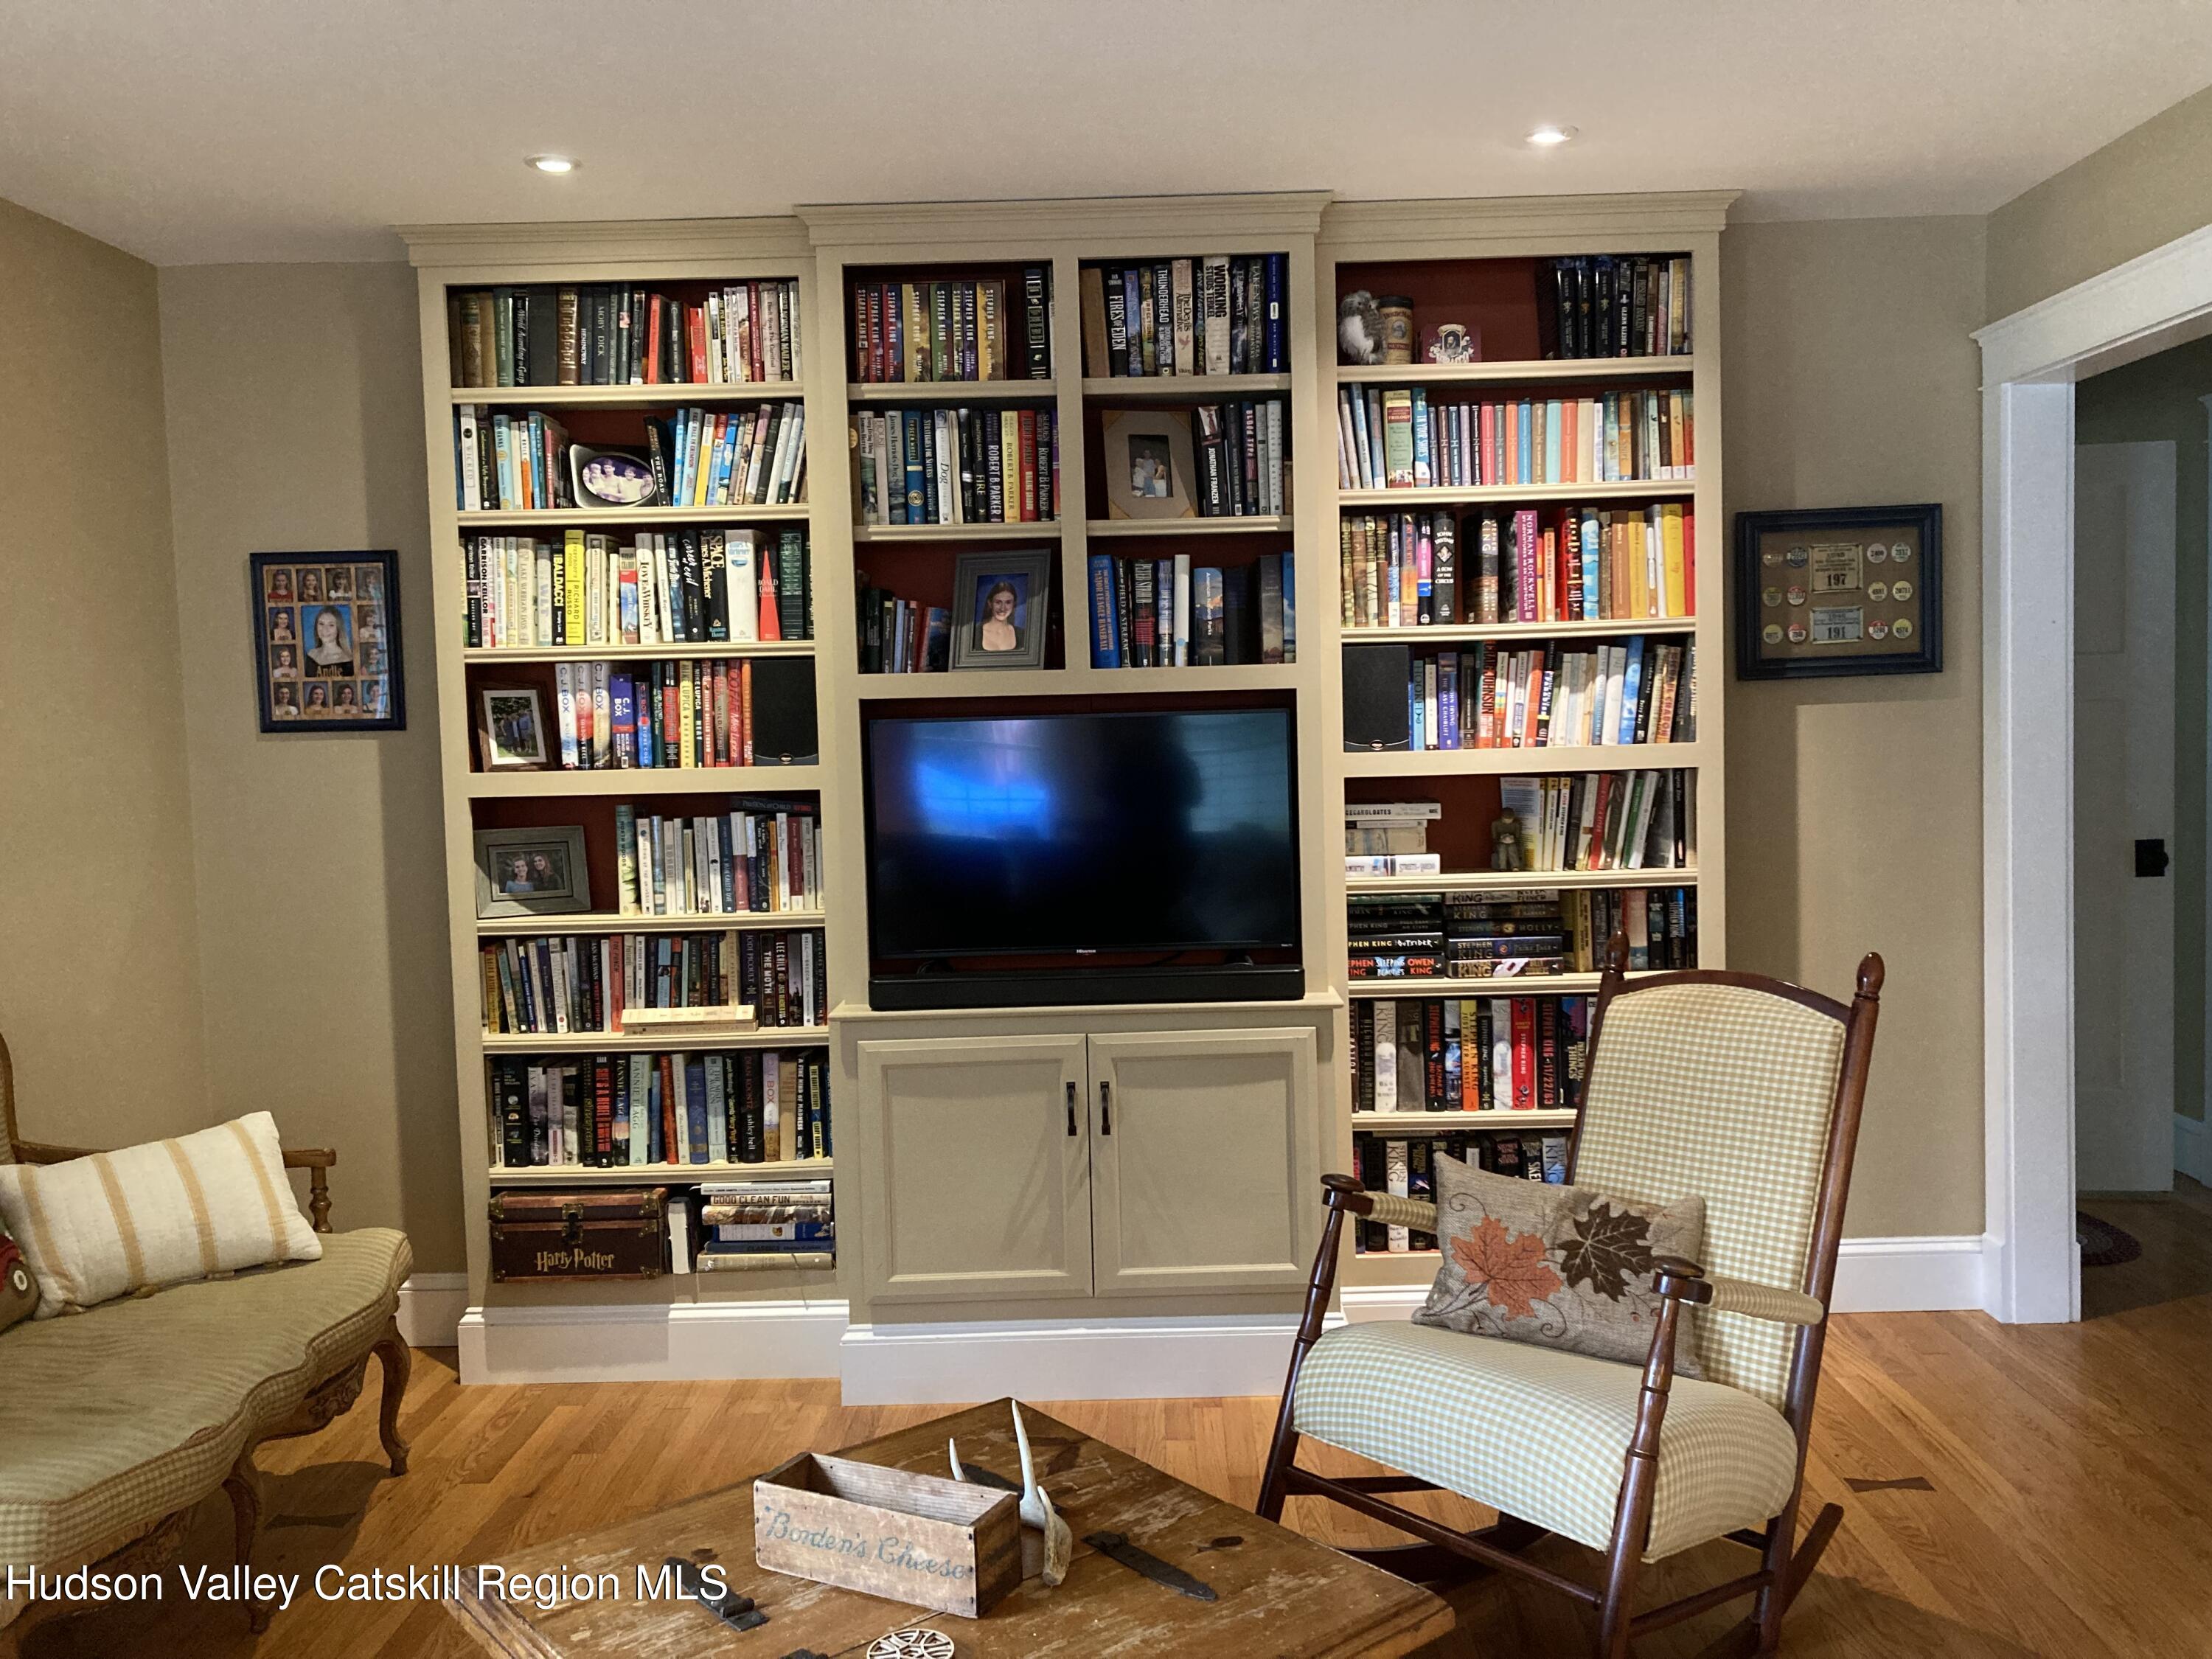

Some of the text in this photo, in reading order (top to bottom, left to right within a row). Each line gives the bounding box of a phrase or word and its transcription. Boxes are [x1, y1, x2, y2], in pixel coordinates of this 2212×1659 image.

[965, 291, 973, 320] STEPHEN
[1158, 269, 1170, 323] THUNDERHEAD
[1206, 265, 1215, 319] STUDS TERKEL
[1213, 265, 1227, 318] WORKING
[1252, 265, 1261, 321] LAKE NEWS
[888, 293, 897, 343] STEPHEN KING
[937, 291, 946, 340] STEPHEN KING
[1109, 295, 1124, 321] FIRES
[1175, 293, 1186, 332] Alternative
[1184, 292, 1192, 331] The Devils
[987, 323, 995, 339] KING
[1112, 327, 1127, 350] EDEN
[516, 309, 526, 383] World According Garp
[782, 343, 790, 370] MAILER
[495, 419, 504, 448] TOM HANKS
[1417, 424, 1427, 438] YOUR
[988, 445, 1000, 476] ROBERT
[1038, 448, 1047, 475] ROBERT
[1418, 439, 1428, 457] SHOES
[657, 473, 665, 493] ROAD
[939, 462, 949, 484] Dog
[975, 474, 985, 495] FIRE
[1208, 448, 1219, 504] JONATHAN FRANZEN
[990, 485, 1001, 515] PARKER
[1040, 484, 1048, 511] PARKER
[1523, 515, 1527, 523] MY
[1482, 520, 1490, 551] KING
[683, 539, 697, 566] career
[709, 536, 725, 568] SPACE
[1526, 515, 1535, 611] NORMAN ROCKWELL
[554, 556, 564, 607] BALDACCI
[684, 566, 699, 586] evil
[1826, 574, 1847, 586] 197
[540, 584, 549, 616] WLT
[1119, 585, 1127, 607] FIELD
[1120, 617, 1129, 650] STREAM
[1826, 626, 1846, 639] 191
[623, 698, 630, 706] C.
[682, 664, 691, 711] MIKE LUPICA
[614, 698, 622, 716] BOX
[731, 732, 739, 757] Lupica
[1453, 893, 1483, 903] KING
[1453, 911, 1487, 919] KING
[746, 934, 755, 982] JODI PICOULT
[1458, 948, 1493, 959] KING
[764, 951, 773, 993] THE MOTH
[1458, 967, 1492, 978] KING
[1376, 1007, 1388, 1044] KING
[1468, 1011, 1478, 1090] STEPHEN KING
[1568, 1046, 1578, 1079] THINGS
[617, 1060, 625, 1116] FANNIE FLAGG
[632, 1061, 640, 1129] FANNIE FLAGG
[746, 1114, 755, 1135] ashley
[748, 1137, 756, 1150] bell
[1388, 1146, 1399, 1182] KING
[1399, 1145, 1407, 1183] STEPHEN
[714, 1195, 736, 1204] GOOD
[739, 1195, 770, 1204] CLEAN
[772, 1195, 790, 1204] FUN
[534, 1248, 615, 1272] Harry Potter
[768, 1511, 965, 1579] Borden's Cheese
